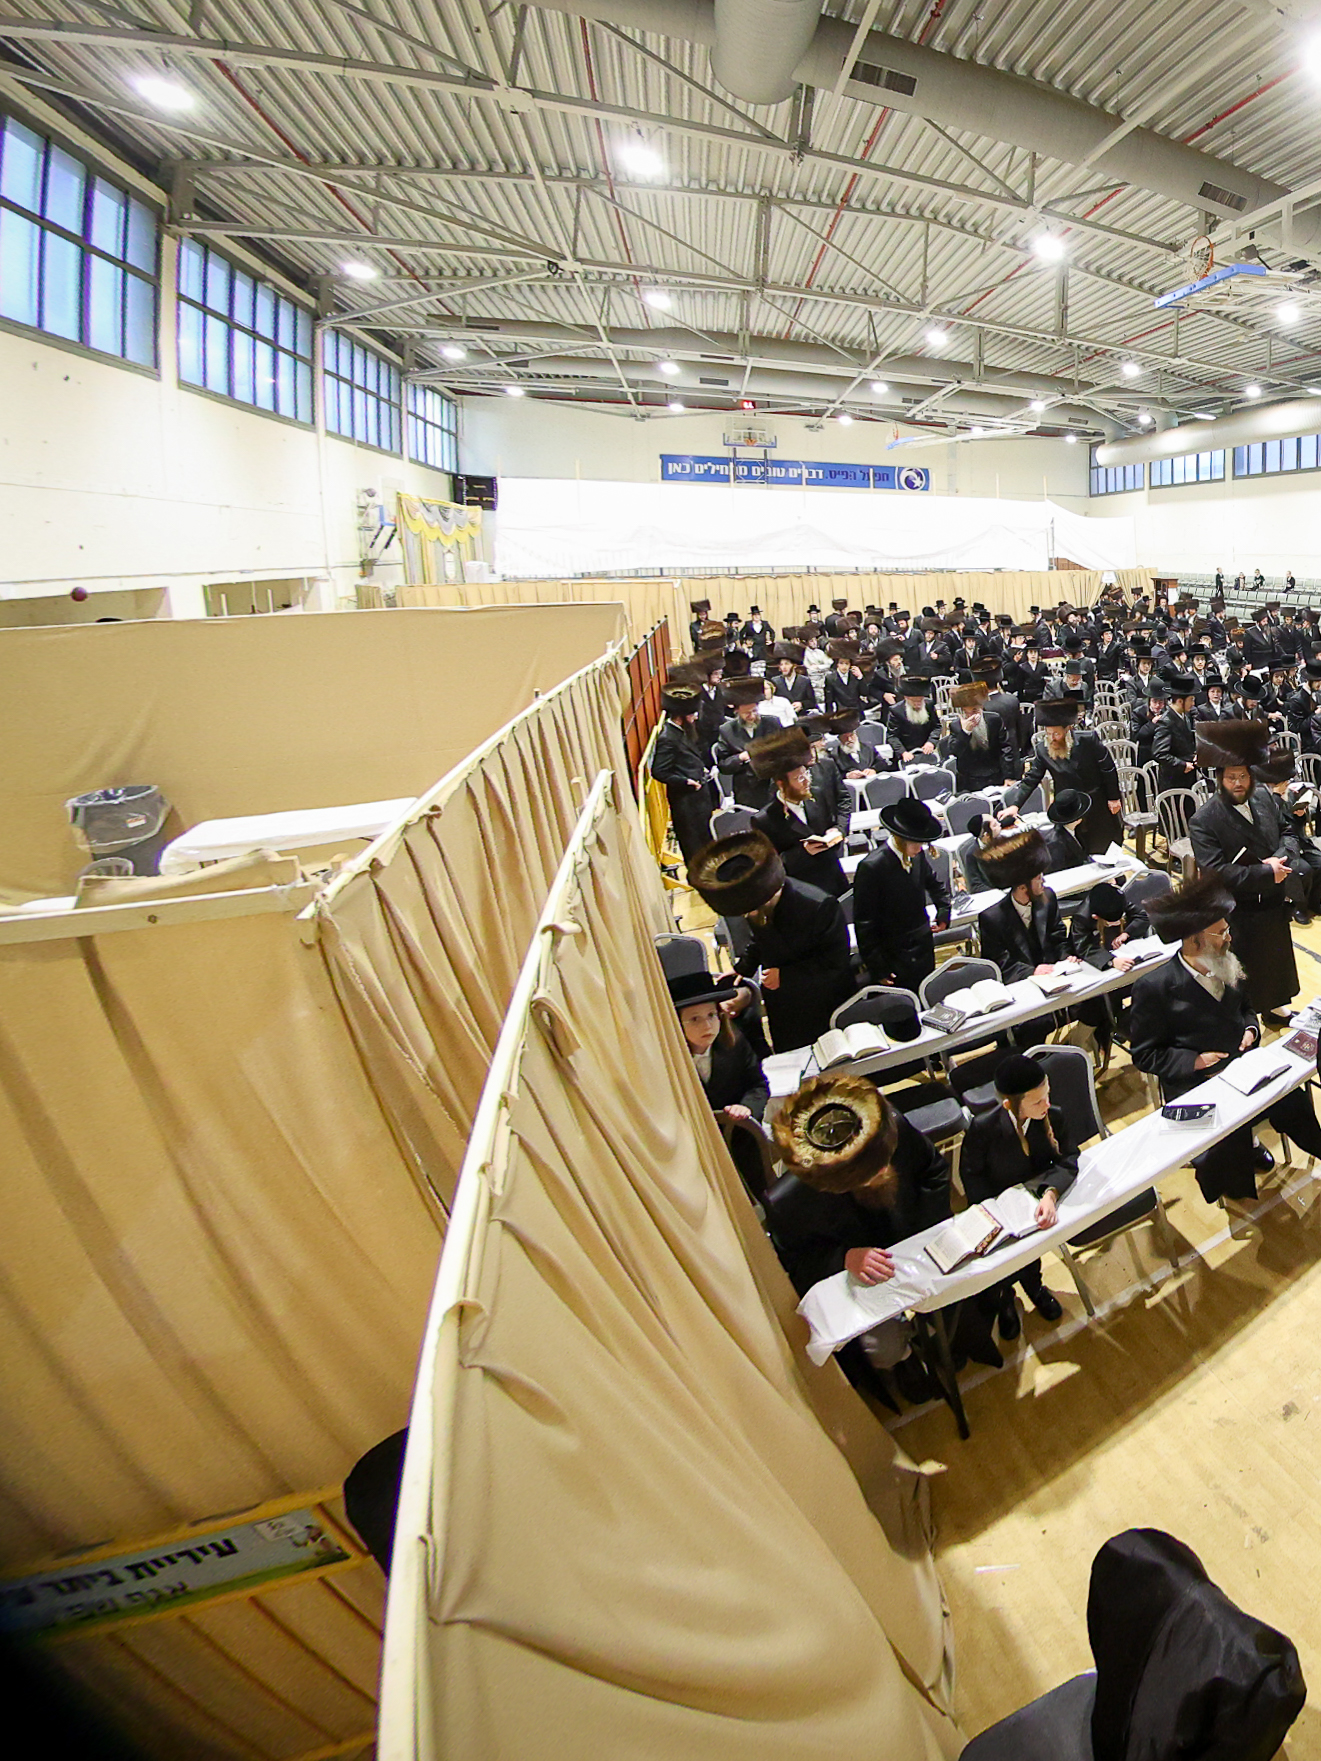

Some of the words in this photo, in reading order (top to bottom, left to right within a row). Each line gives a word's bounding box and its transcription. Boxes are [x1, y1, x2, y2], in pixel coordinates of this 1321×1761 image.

[667, 462, 691, 475] כאן
[751, 465, 786, 478] טובים
[123, 1537, 239, 1580] עיריית
